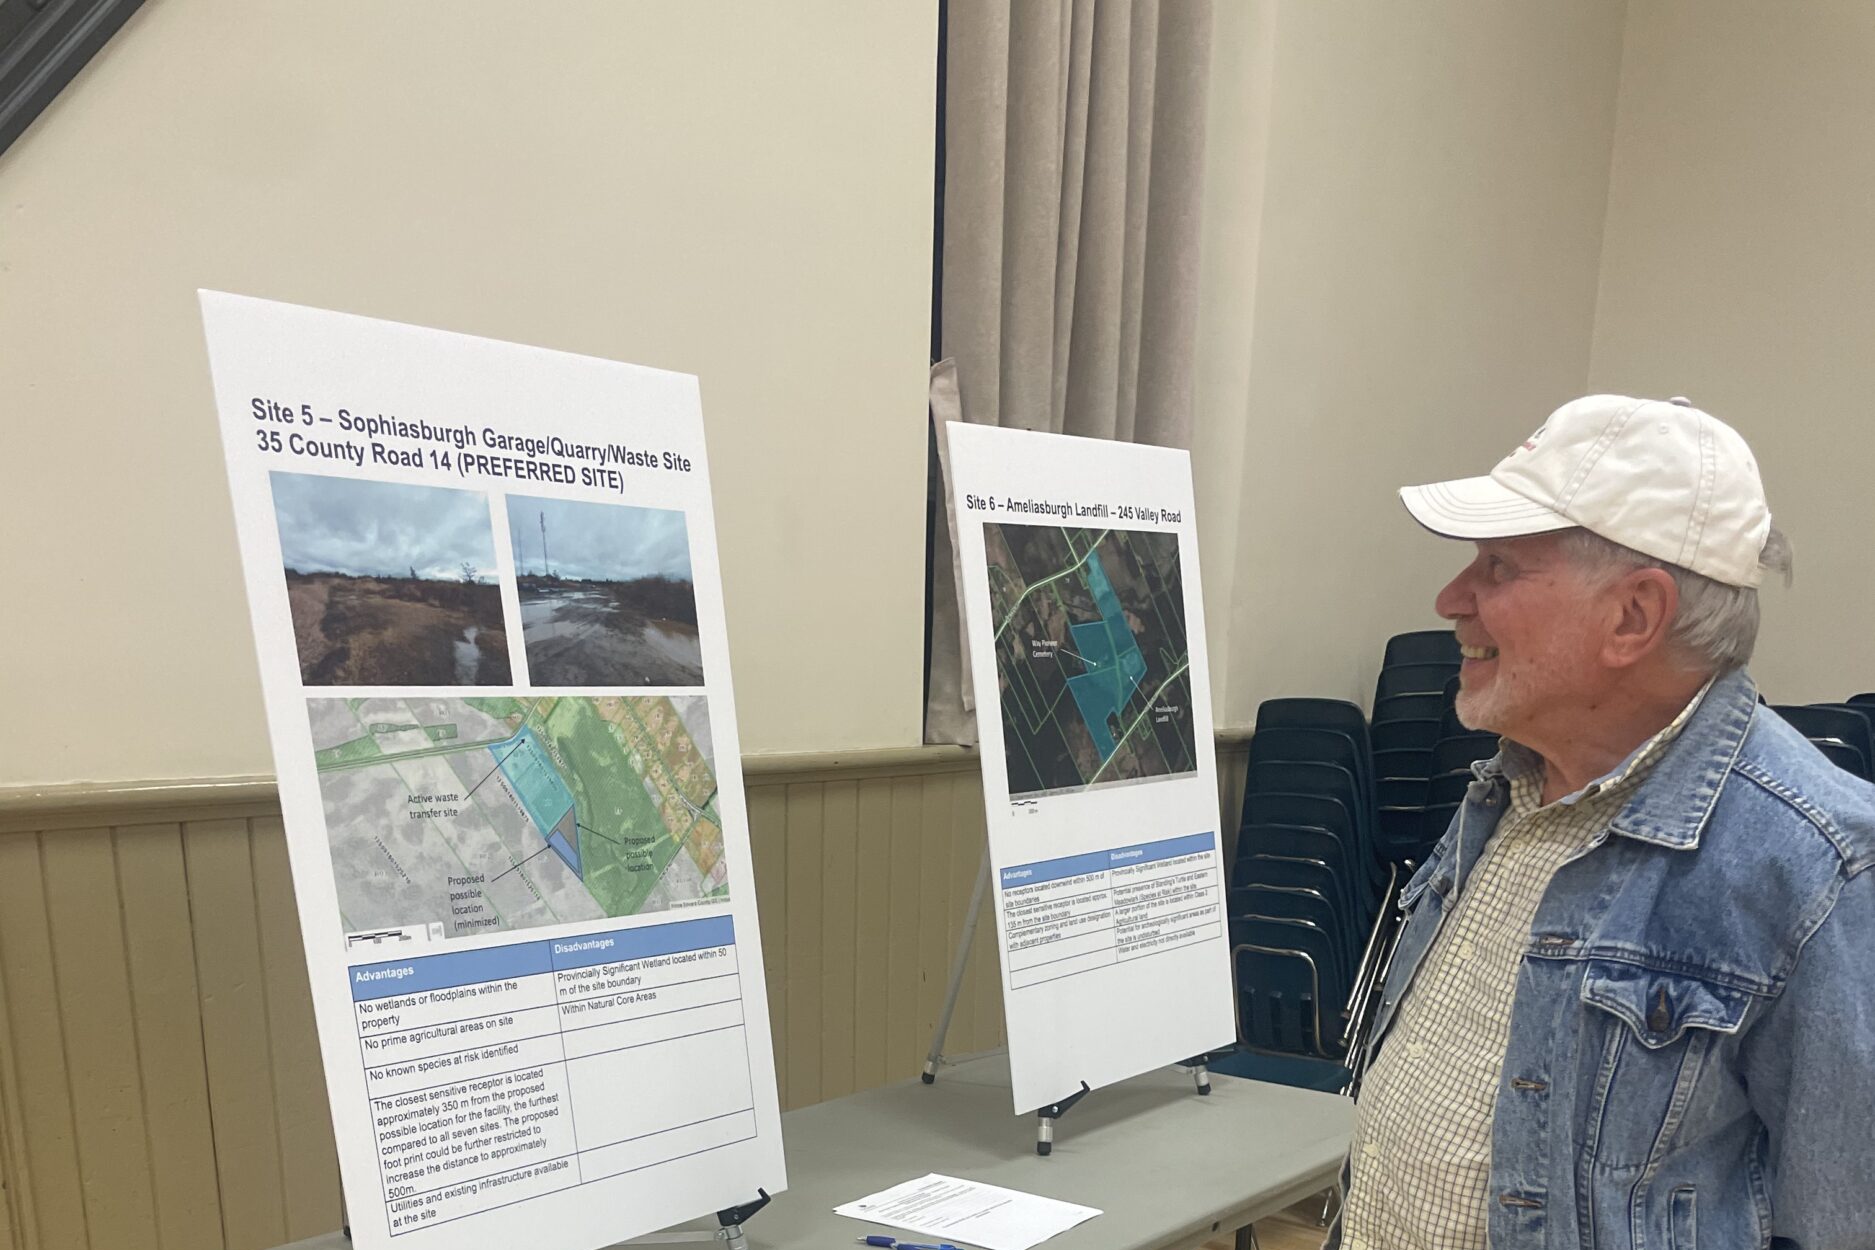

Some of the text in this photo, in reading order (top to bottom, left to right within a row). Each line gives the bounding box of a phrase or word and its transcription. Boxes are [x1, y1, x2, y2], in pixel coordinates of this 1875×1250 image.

[252, 398, 294, 424] Site
[301, 404, 313, 426] 5
[338, 409, 476, 449] Sophiasburgh
[482, 428, 658, 468] Garage/Quarry/Waste
[663, 451, 691, 472] Site
[256, 429, 624, 494] 35 County Road 14 (PREFERRED SITE)
[966, 494, 986, 510] Site
[989, 496, 995, 511] 6
[1006, 497, 1073, 519] Ameliasburgh
[1075, 503, 1108, 517] Landfill
[1118, 505, 1133, 520] 245
[1135, 507, 1159, 524] Valley
[1161, 509, 1181, 523] Road
[408, 793, 459, 804] Active waste
[409, 808, 459, 819] transfer site
[447, 873, 485, 886] Proposed
[450, 888, 483, 902] possible
[451, 904, 484, 915] location
[454, 915, 500, 932] (minimized)
[554, 939, 614, 954] Disadvantages
[356, 967, 414, 982] Advantages
[557, 947, 727, 982] Provincially Significant Wetland located within 50
[359, 982, 518, 1014] No wetlands or floodplains within the
[559, 976, 641, 996] m of the site boundary
[561, 992, 657, 1015] Within Natural Core Areas
[361, 1015, 400, 1031] property
[364, 1017, 513, 1050] No prime agricultural areas on site
[369, 1044, 519, 1080] No known species at risk identified
[374, 1068, 544, 1111] The closest sensitive receptor is located
[377, 1082, 545, 1127] approximately 350 m from the proposed
[379, 1125, 417, 1143] possible
[419, 1118, 453, 1132] location
[455, 1114, 467, 1123] for
[468, 1111, 482, 1121] the
[514, 1101, 527, 1111] the
[528, 1093, 559, 1107] furthest
[381, 1137, 427, 1156] compared
[428, 1136, 438, 1145] to
[440, 1131, 450, 1142] all
[452, 1126, 478, 1139] seven
[503, 1117, 519, 1126] The
[521, 1106, 559, 1125] proposed
[383, 1126, 541, 1170] foot print could be further restricted to
[386, 1138, 547, 1184] increase the distance to approximately
[390, 1160, 568, 1213] Utilities and existing infrastructure available
[393, 1209, 436, 1228] at the site
